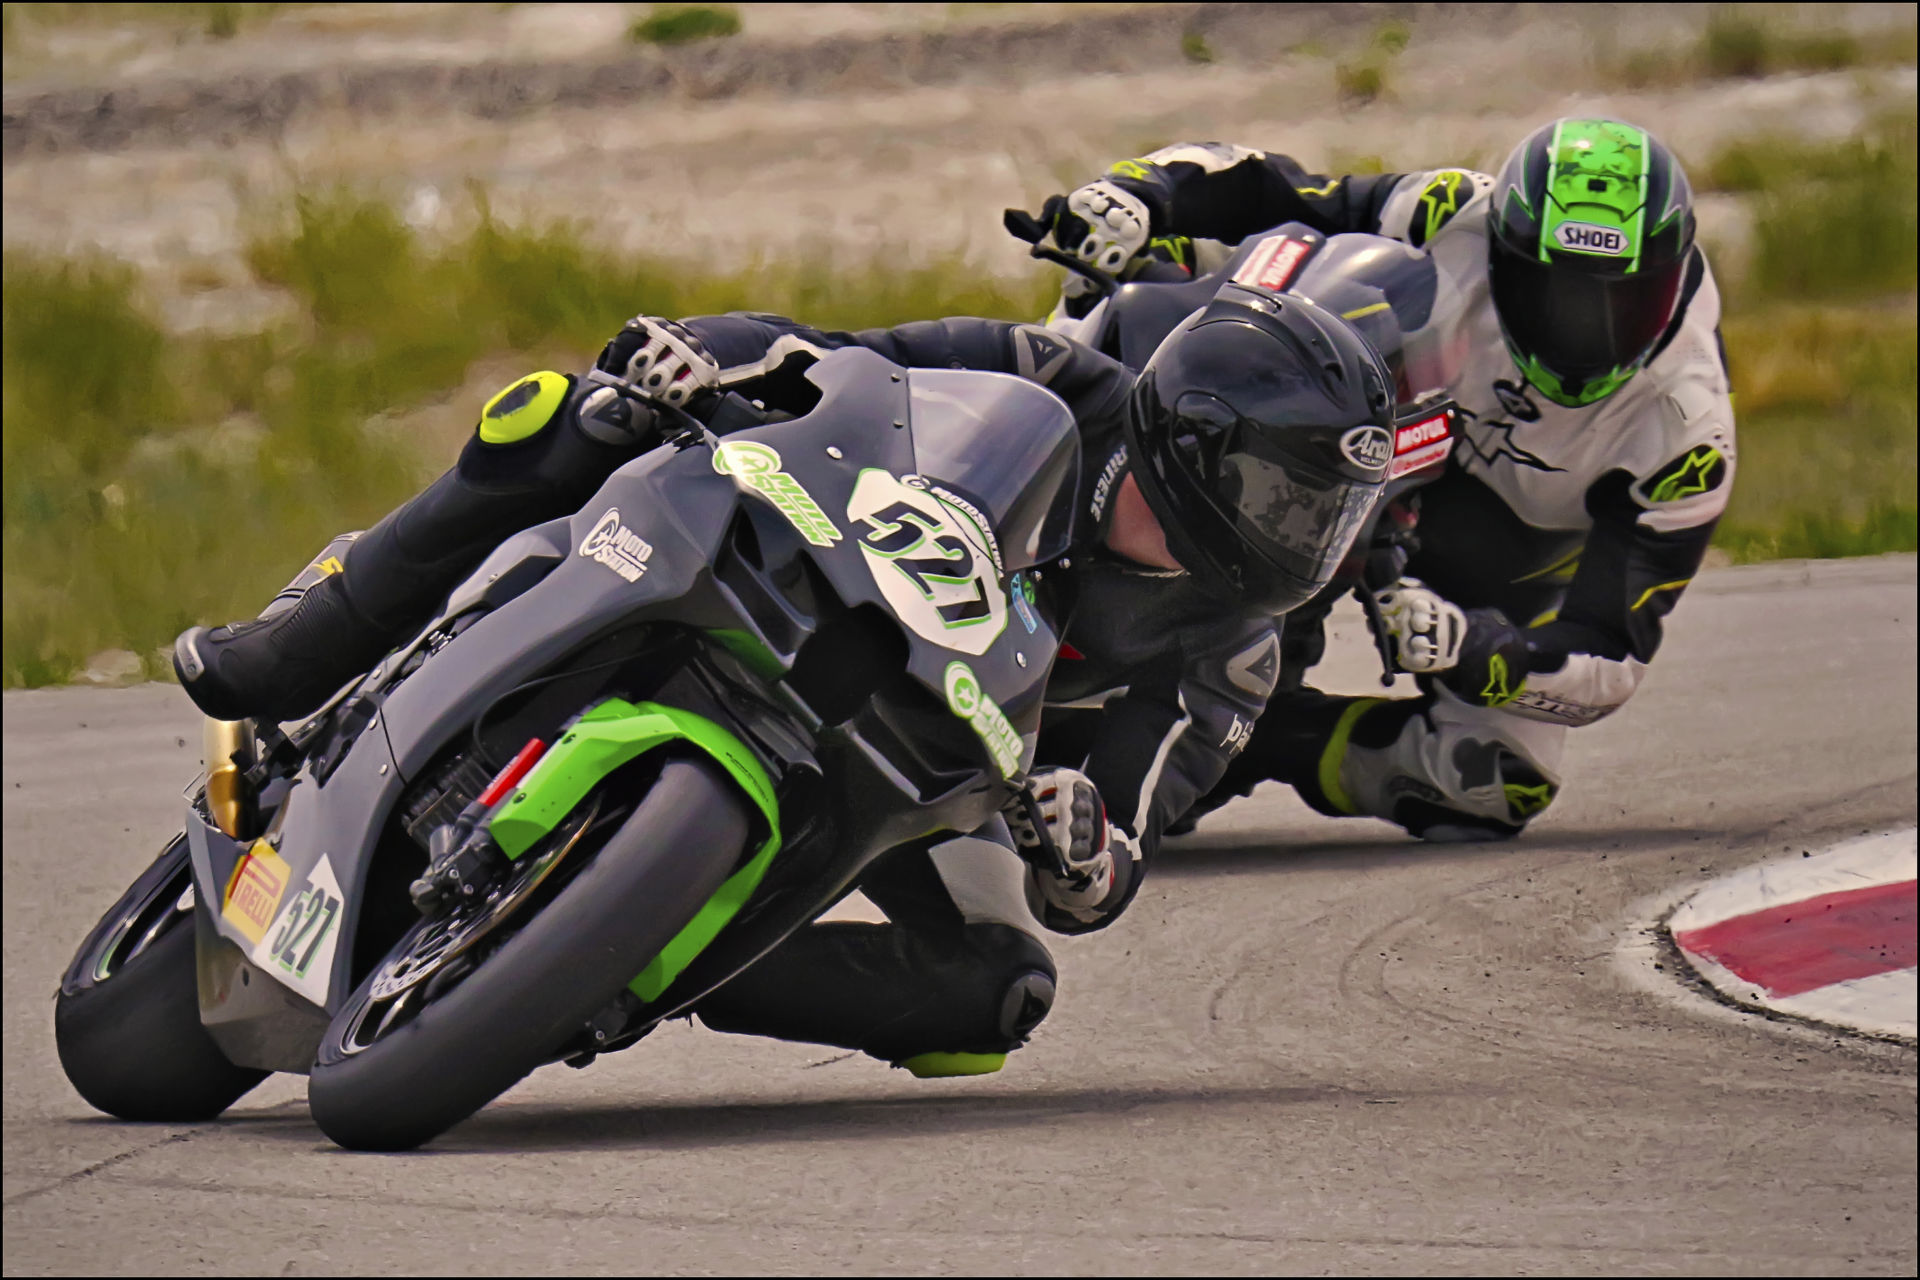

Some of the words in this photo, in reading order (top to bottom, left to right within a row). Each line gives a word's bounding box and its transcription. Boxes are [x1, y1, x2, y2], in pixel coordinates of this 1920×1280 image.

[1564, 227, 1620, 250] SHOEI
[1398, 416, 1447, 450] MOTUL
[609, 525, 654, 563] MOTO
[849, 500, 994, 629] 527
[269, 880, 341, 979] 527
